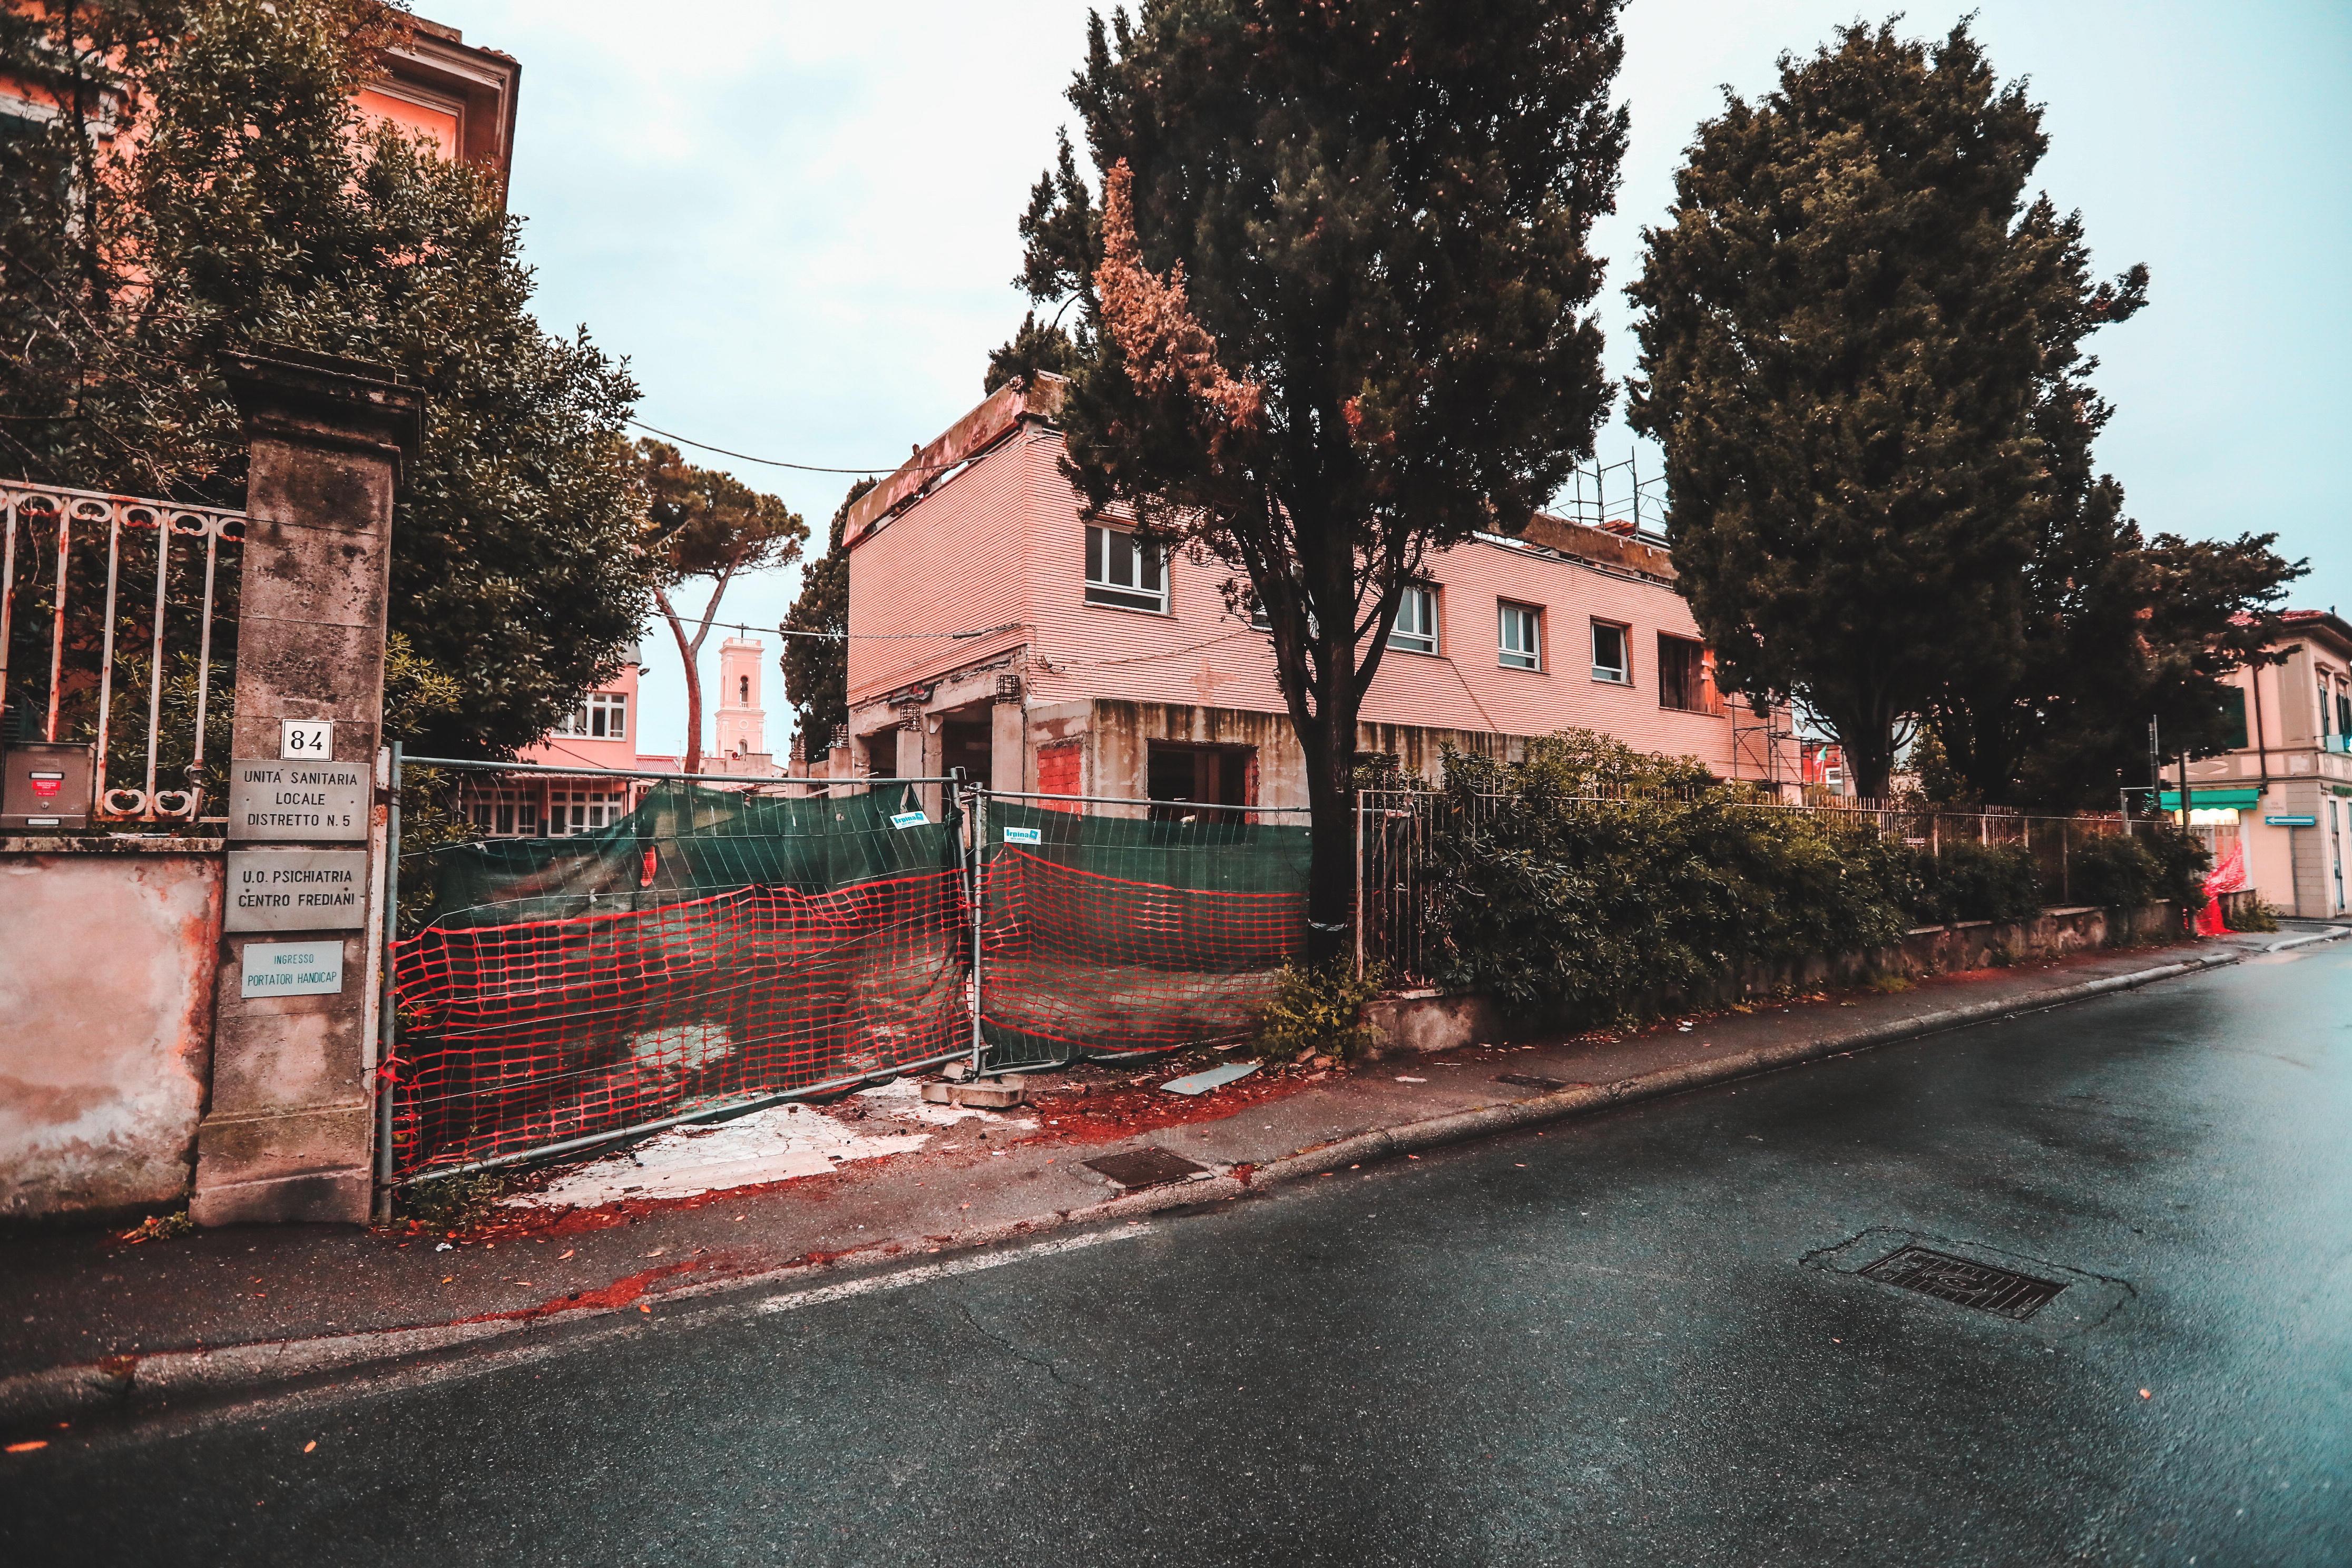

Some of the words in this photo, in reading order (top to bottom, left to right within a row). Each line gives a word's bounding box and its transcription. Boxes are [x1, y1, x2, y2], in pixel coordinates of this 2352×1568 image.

[290, 730, 322, 750] 84
[291, 772, 357, 785] SANITARIA
[276, 792, 325, 805] LOCALE
[248, 814, 319, 826] DISTRETTO
[327, 815, 338, 826] N.
[343, 815, 350, 826] 5
[1006, 829, 1029, 838] Irpina
[243, 870, 268, 883] U.O.
[273, 870, 352, 883] PSICHIATRIA
[238, 895, 290, 907] CENTRO
[298, 894, 355, 906] FREDIANI
[274, 954, 314, 965] INGRESSO
[248, 974, 293, 986] PORTATORI
[297, 972, 337, 983] HANDICAP
